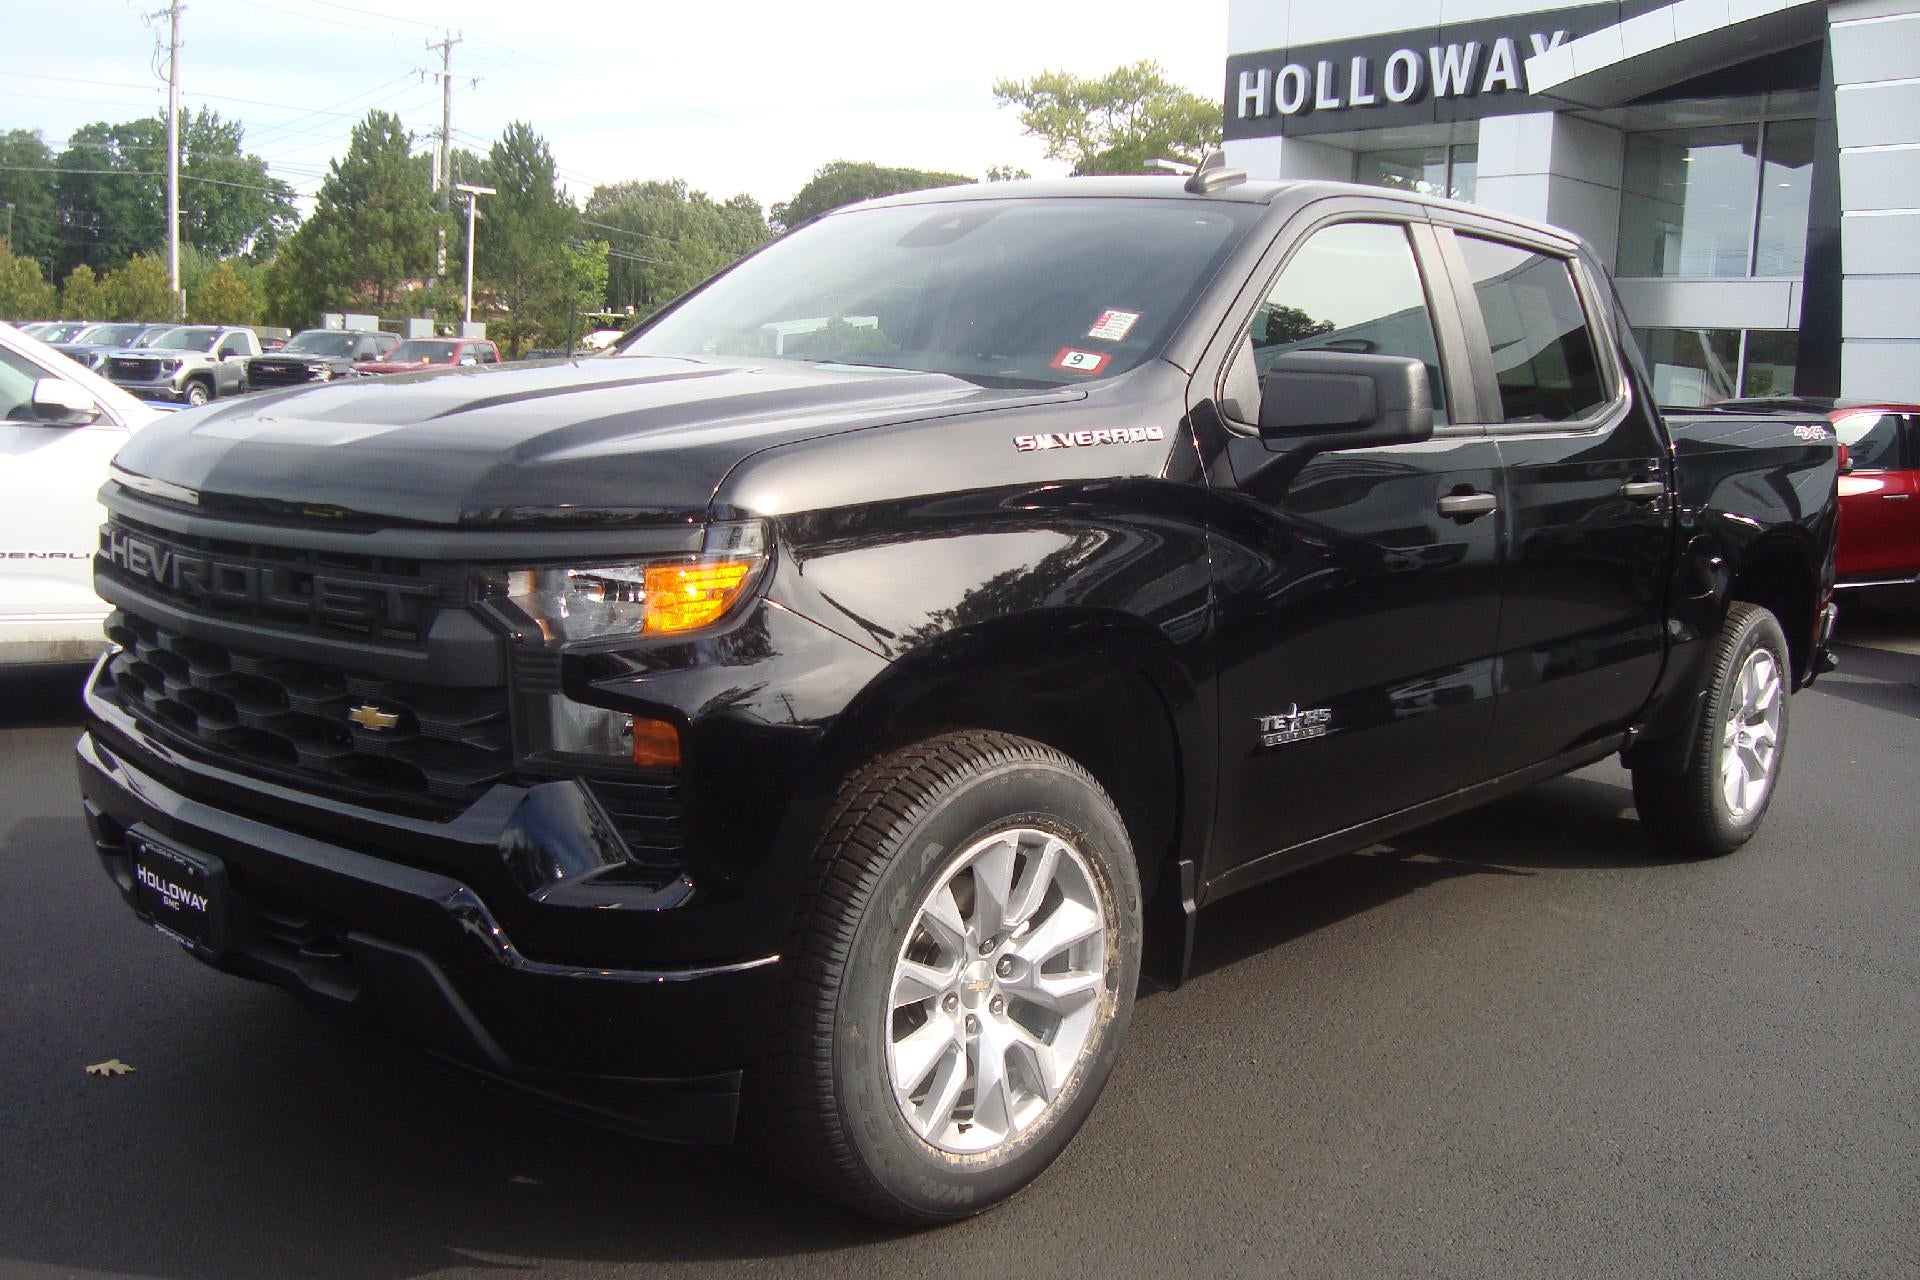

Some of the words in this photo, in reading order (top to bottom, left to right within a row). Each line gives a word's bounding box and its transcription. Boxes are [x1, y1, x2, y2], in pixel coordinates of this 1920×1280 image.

[1070, 354, 1084, 365] 9
[1013, 426, 1164, 452] SILVERADO
[98, 526, 440, 622] CHEVROLET
[137, 864, 208, 912] HOLLOWAY
[163, 896, 180, 910] GMC
